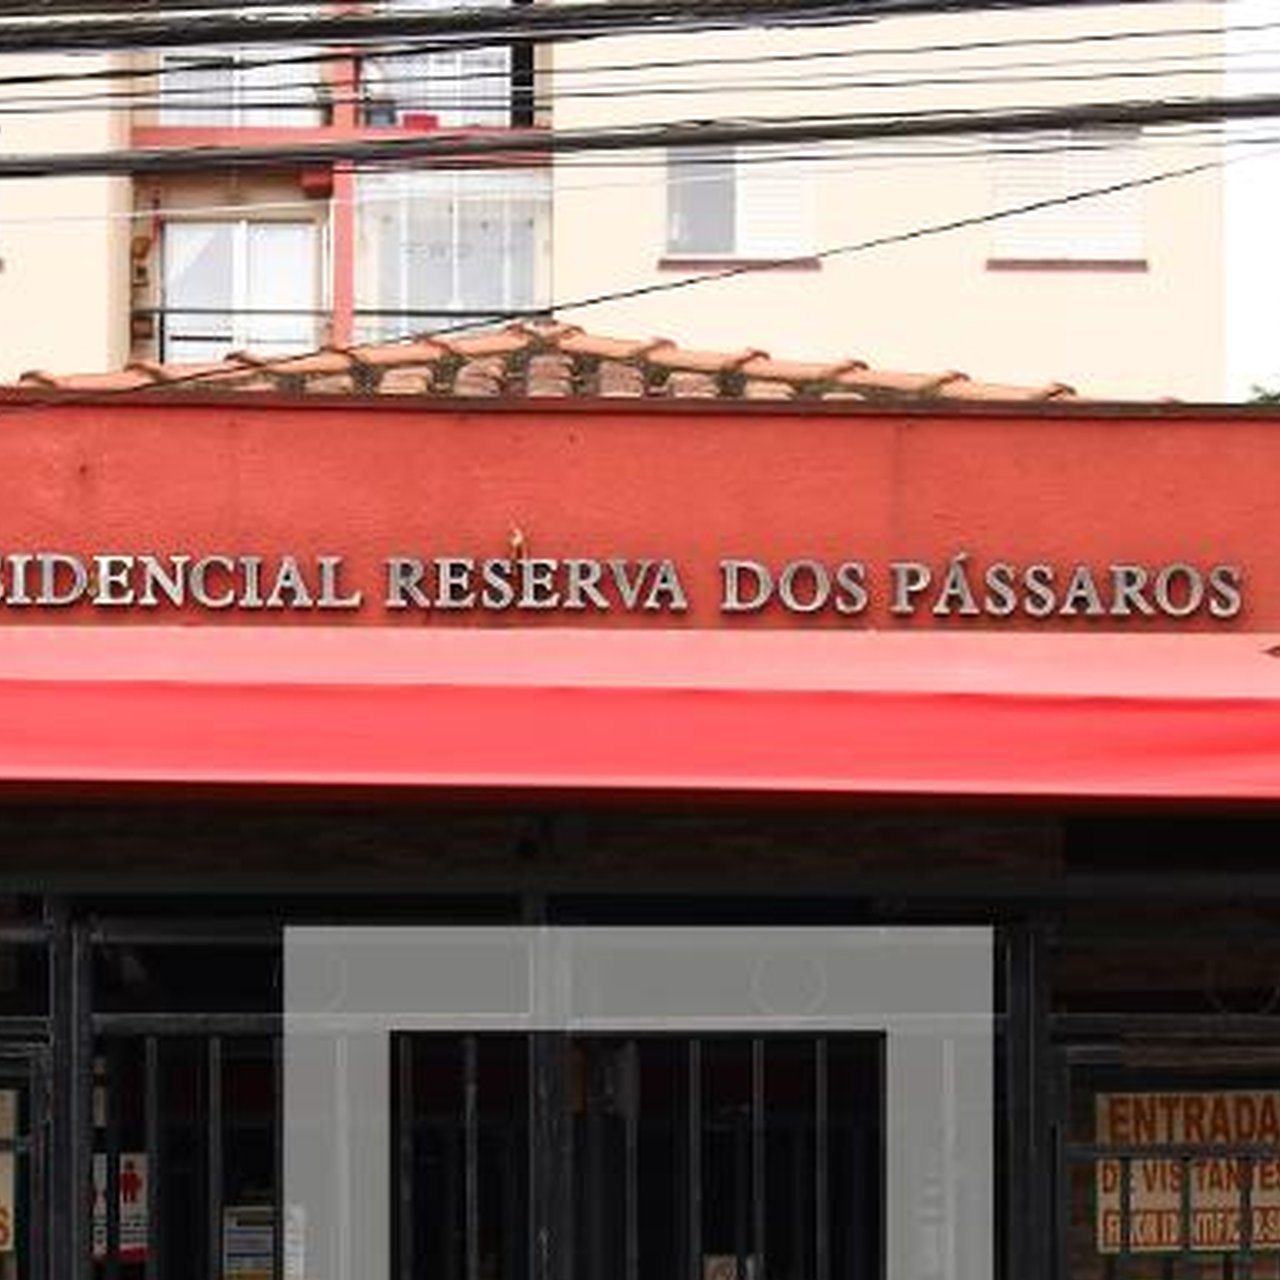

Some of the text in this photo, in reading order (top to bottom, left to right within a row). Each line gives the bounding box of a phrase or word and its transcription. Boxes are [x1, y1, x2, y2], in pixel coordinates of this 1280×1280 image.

[386, 556, 688, 612] RESERVA
[720, 559, 868, 615] DOS
[890, 553, 1243, 618] PÁSSAROS
